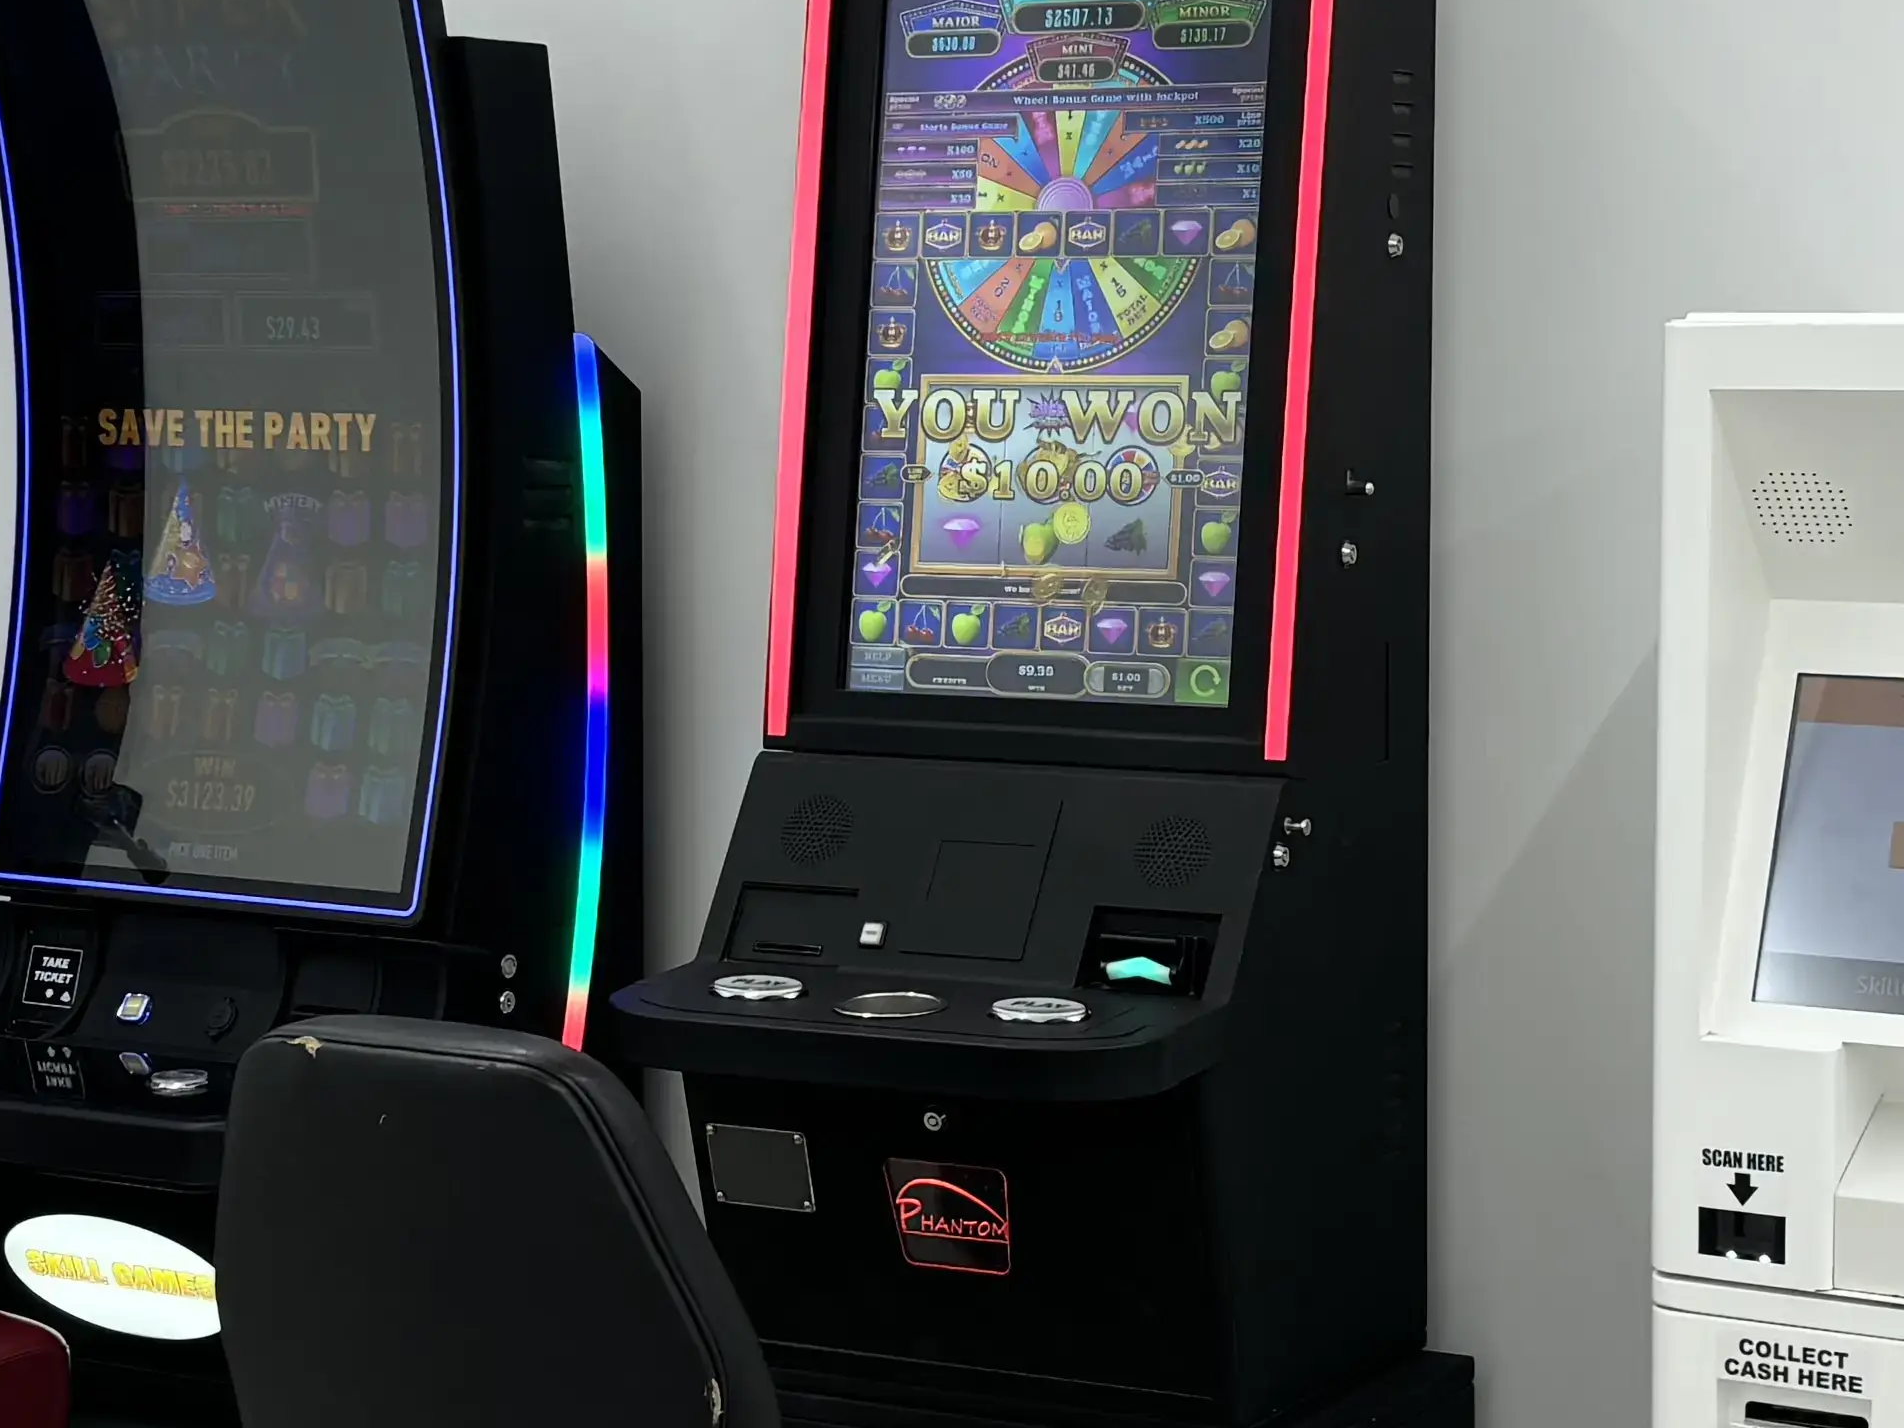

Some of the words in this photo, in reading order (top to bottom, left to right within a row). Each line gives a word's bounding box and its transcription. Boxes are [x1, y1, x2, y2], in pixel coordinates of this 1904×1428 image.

[1045, 7, 1113, 28] $2507.13
[1179, 6, 1230, 18] MINOR
[1062, 44, 1093, 55] MINI
[1014, 97, 1047, 105] Wheel
[1053, 95, 1086, 104] Bonus
[1091, 95, 1122, 103] Game
[1126, 93, 1152, 102] with
[1195, 115, 1224, 124] X500
[928, 231, 960, 242] BAR
[1071, 230, 1103, 240] BAR
[873, 388, 1022, 443] YOU
[1060, 389, 1242, 446] WON
[98, 408, 184, 447] SAVE
[194, 410, 254, 449] THE
[264, 411, 376, 452] PARTY
[959, 457, 1144, 503] $10.00
[1047, 623, 1081, 635] BAR
[42, 956, 70, 969] TAKE
[34, 971, 74, 984] TICKET
[732, 977, 788, 987] PLAY
[1010, 1000, 1071, 1009] PLAY
[1702, 1148, 1744, 1169] SCAN
[1747, 1152, 1784, 1172] HERE
[897, 1196, 1008, 1238] PHANTOM
[25, 1249, 103, 1283] SKILL
[111, 1261, 216, 1300] GAMES
[1738, 1338, 1849, 1370] COLLECT
[1724, 1357, 1789, 1384] CASH
[1797, 1368, 1863, 1394] HERE
